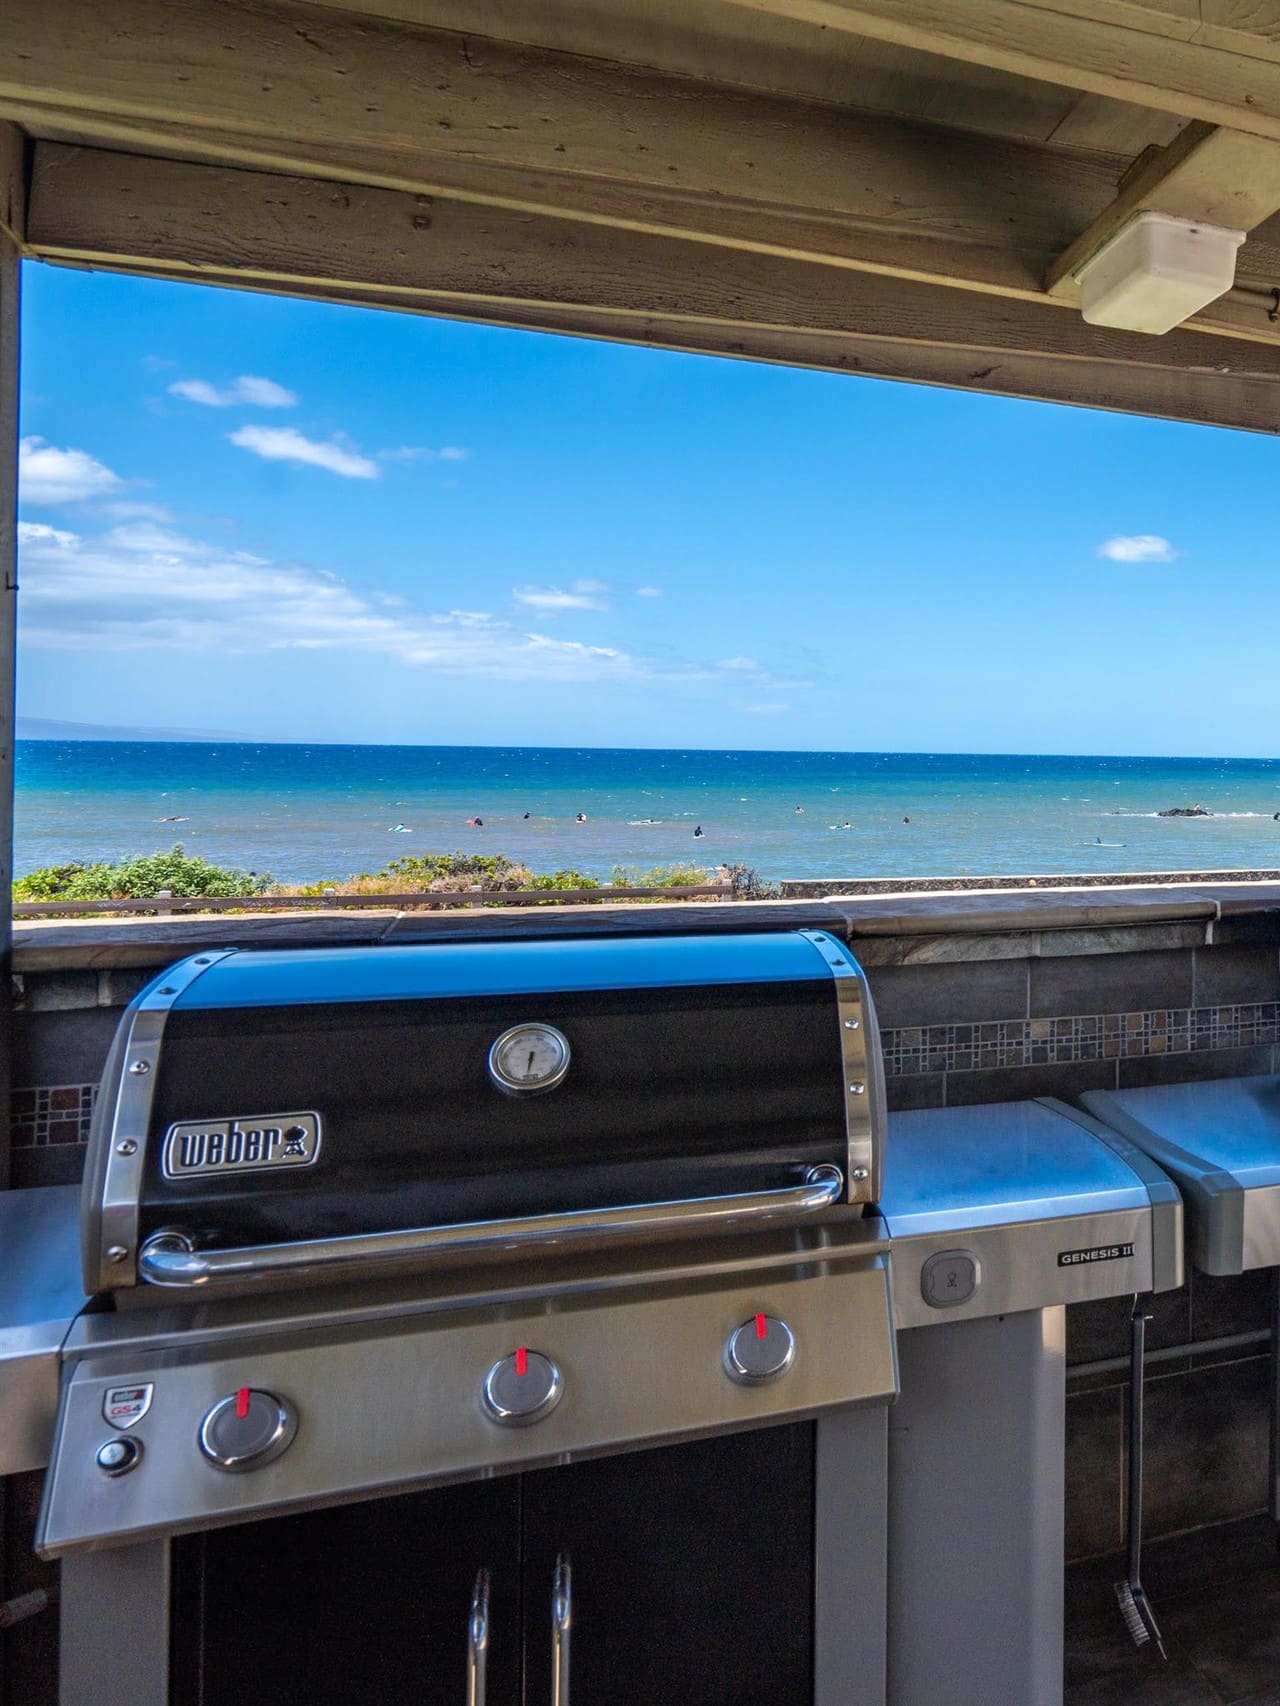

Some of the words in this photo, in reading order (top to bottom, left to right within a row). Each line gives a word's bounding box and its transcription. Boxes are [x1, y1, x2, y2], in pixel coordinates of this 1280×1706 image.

[181, 1121, 281, 1167] weber
[1062, 1247, 1119, 1264] GENESIS
[1122, 1246, 1131, 1255] II
